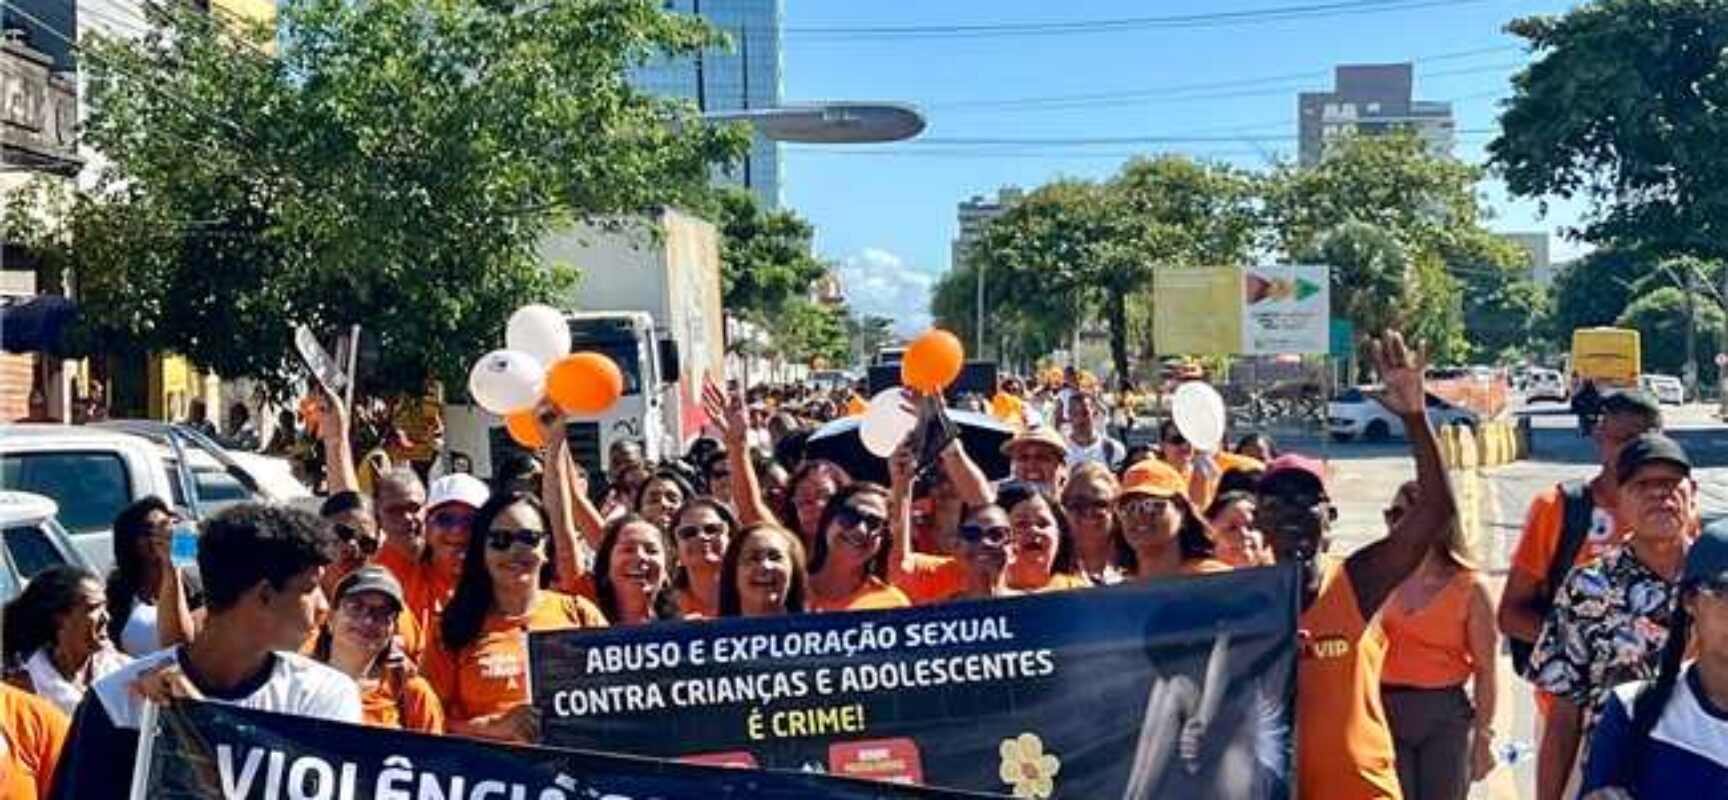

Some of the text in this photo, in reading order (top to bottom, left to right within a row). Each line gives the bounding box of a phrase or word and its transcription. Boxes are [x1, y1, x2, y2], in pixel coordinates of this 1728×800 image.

[586, 616, 1014, 673] ABUSO E EXPLORAÇÃO SEXUAL
[1314, 639, 1349, 659] VIP
[554, 649, 1055, 717] CONTRA CRIANÇAS E ADOLESCENTES
[747, 703, 866, 740] É CRIME!
[217, 744, 566, 800] VIOLÊN
